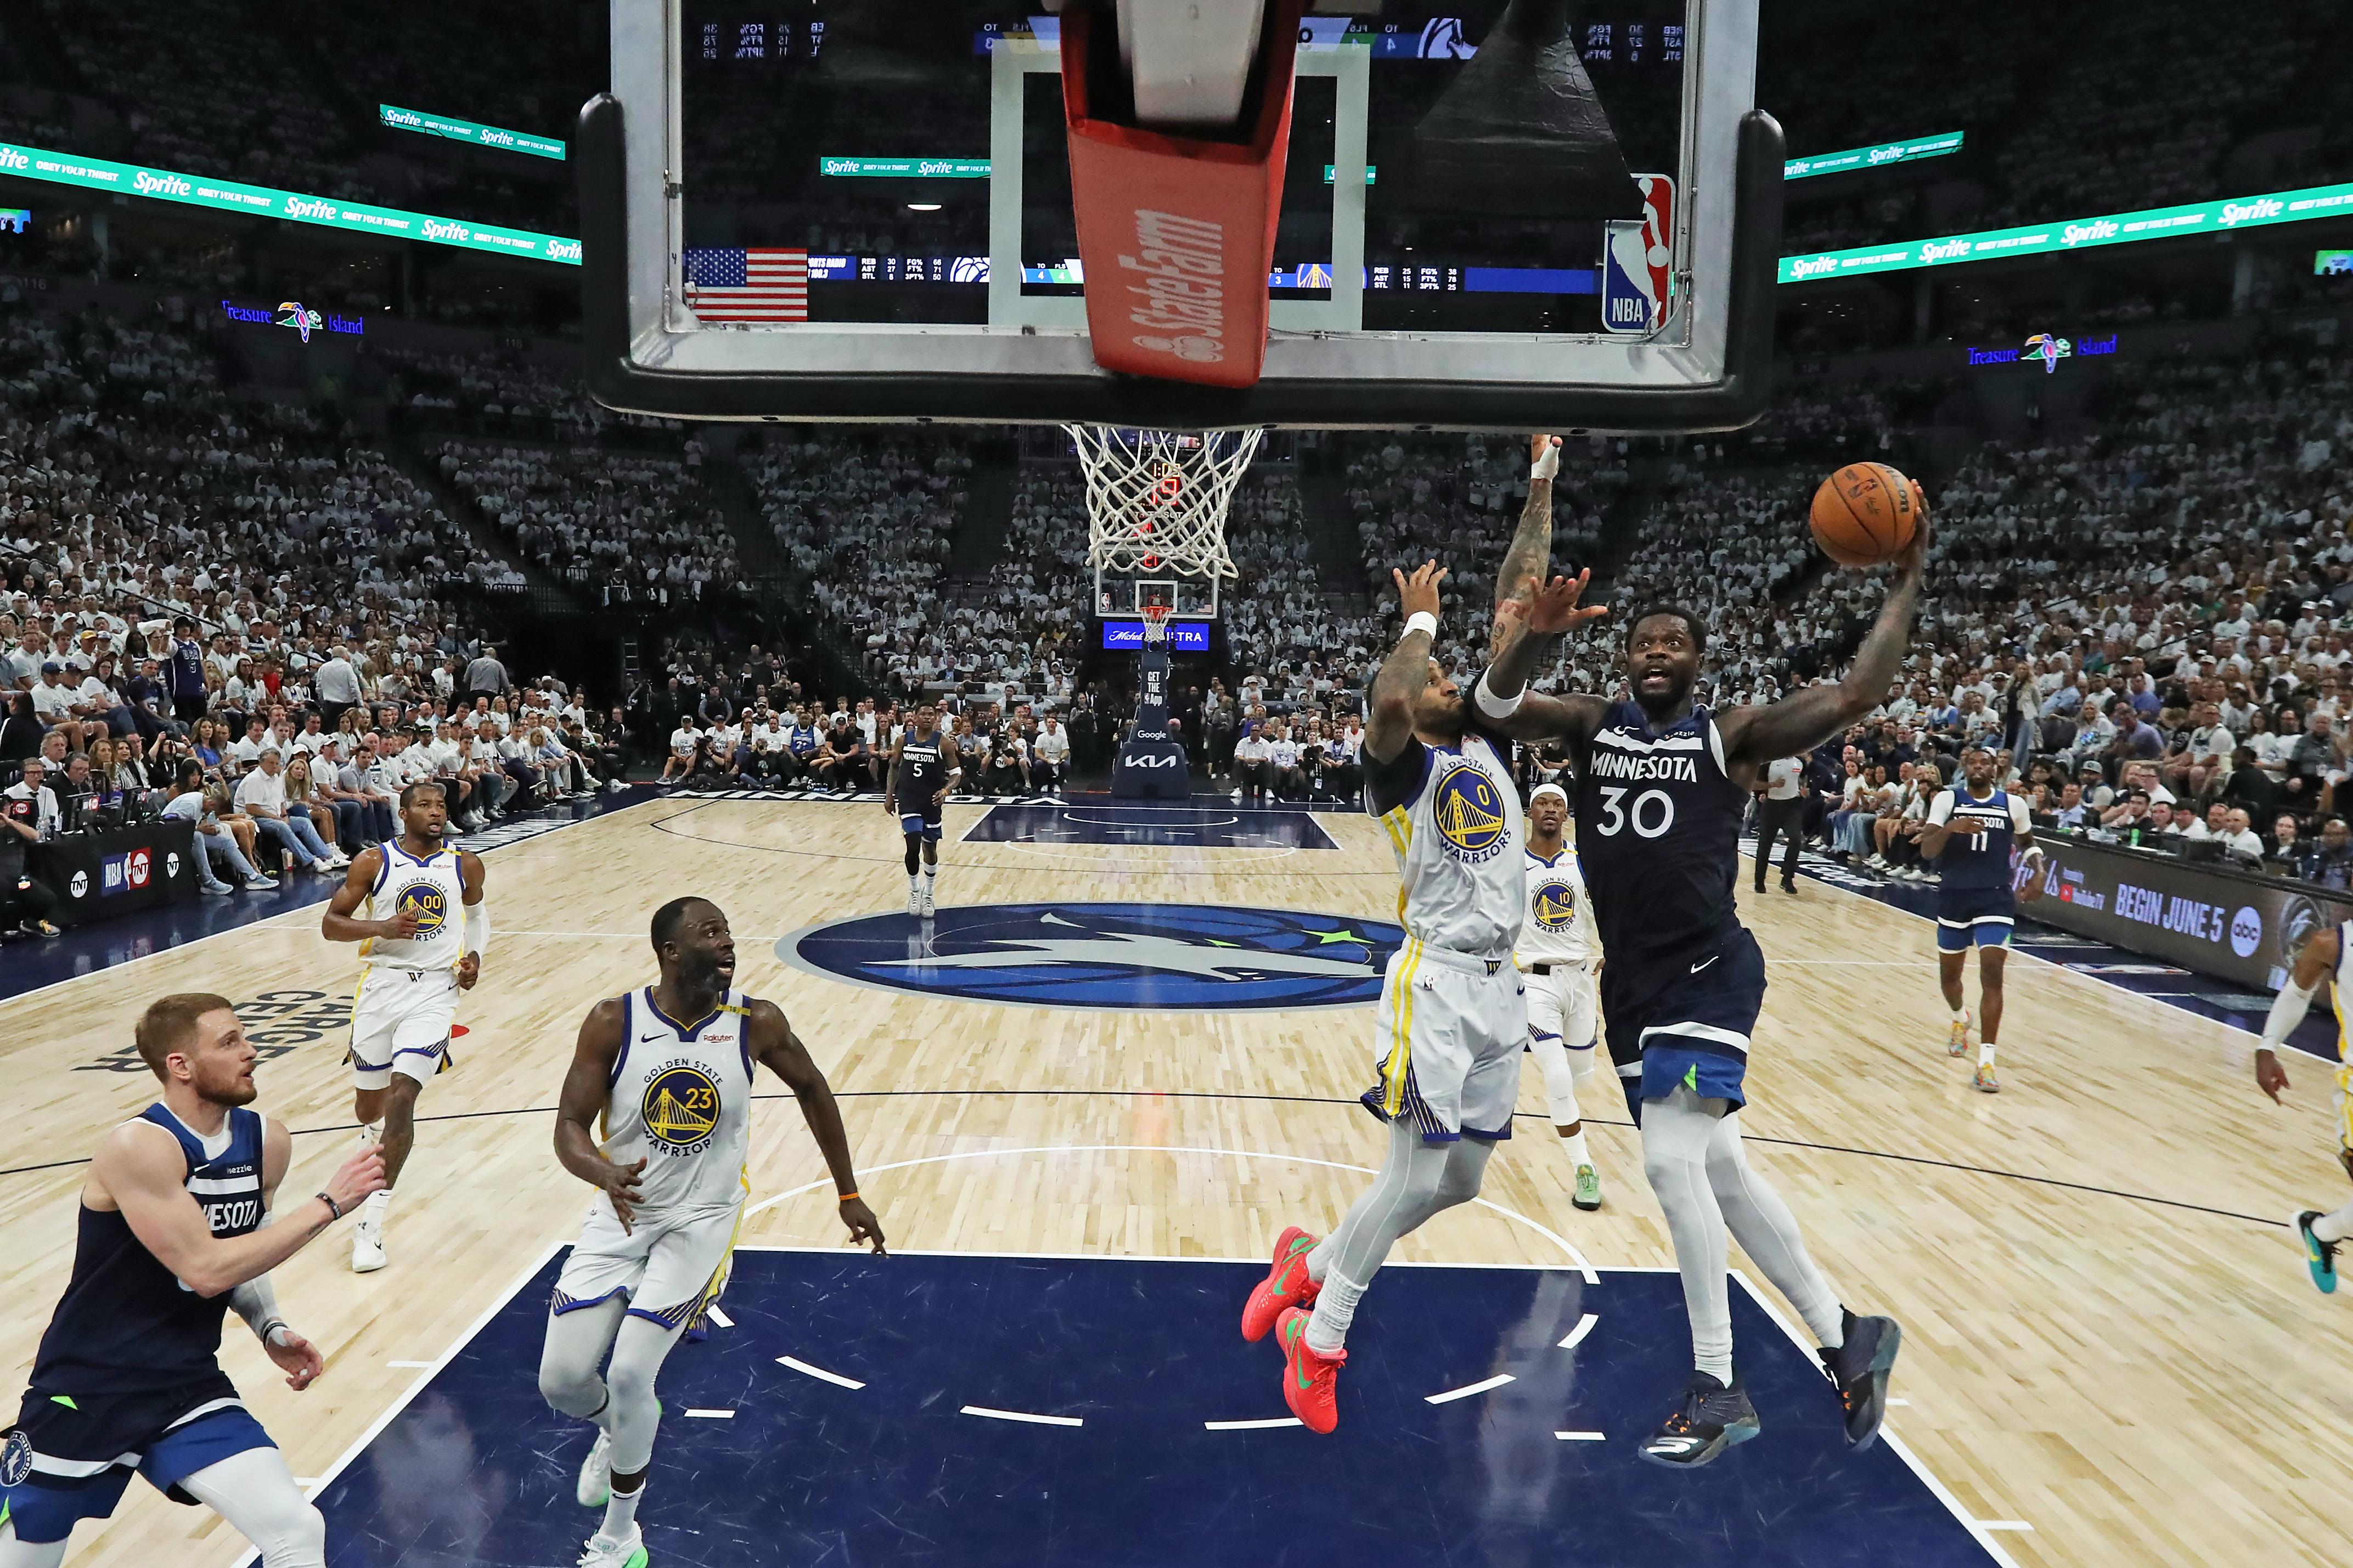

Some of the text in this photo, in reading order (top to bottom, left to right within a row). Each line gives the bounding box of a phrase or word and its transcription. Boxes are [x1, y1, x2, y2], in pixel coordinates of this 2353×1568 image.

[385, 110, 421, 127] Sprite
[480, 129, 514, 145] Sprite
[825, 160, 859, 174] Sprite
[917, 161, 953, 176] Sprite
[1784, 162, 1810, 176] prite
[1867, 146, 1905, 165] Sprite
[0, 148, 29, 170] ite
[36, 160, 61, 173] OBEY
[61, 164, 86, 177] YOUR
[86, 168, 119, 182] THIRST
[133, 171, 191, 196] Sprite
[197, 187, 219, 198] OBEY
[219, 190, 242, 203] YOUR
[242, 194, 272, 207] THIRST
[284, 196, 336, 220] Sprite
[342, 211, 363, 222] OBEY
[384, 217, 409, 229] THIRST
[421, 219, 469, 241] Sprite
[474, 232, 493, 242] OBEY
[511, 238, 536, 250] THIRST
[1790, 199, 2284, 279] Sprite Sprite Sprite Sprite
[808, 258, 846, 268] ORTS RADIO
[811, 269, 829, 279] 100.3
[1038, 271, 1065, 280] 4 4
[1275, 275, 1281, 285] 3
[1126, 277, 1224, 337] State
[1612, 298, 1643, 322] NBA
[222, 301, 364, 334] Treasure Island
[1967, 334, 2118, 365] Treasure Island
[1109, 630, 1144, 641] Michel
[1148, 672, 1160, 682] GET
[1147, 682, 1160, 693] THE
[1150, 693, 1163, 707] App
[1138, 730, 1167, 740] Google
[903, 752, 935, 763] MINNESOTA
[1125, 754, 1176, 768] KIA
[1590, 750, 1697, 783] MINNESOTA
[913, 763, 922, 777] 5
[1468, 758, 1494, 779] STATE
[666, 789, 1069, 805] MINNEOTA
[1477, 783, 1490, 806] 0
[1597, 786, 1674, 838] 30
[1440, 827, 1512, 864] WARRIORS
[105, 862, 121, 888] NBA
[396, 877, 448, 894] GOLDEN STATE
[1531, 877, 1554, 894] GOLDEN
[423, 895, 441, 909] 00
[1559, 892, 1570, 905] 10
[2115, 883, 2226, 943] BEGIN JUNE 5
[415, 923, 447, 941] RIORS
[1534, 914, 1576, 933] WARRIORS
[644, 1058, 723, 1086] GOLDEN STATE
[686, 1088, 712, 1109] 23
[644, 1129, 715, 1157] WARRIOR
